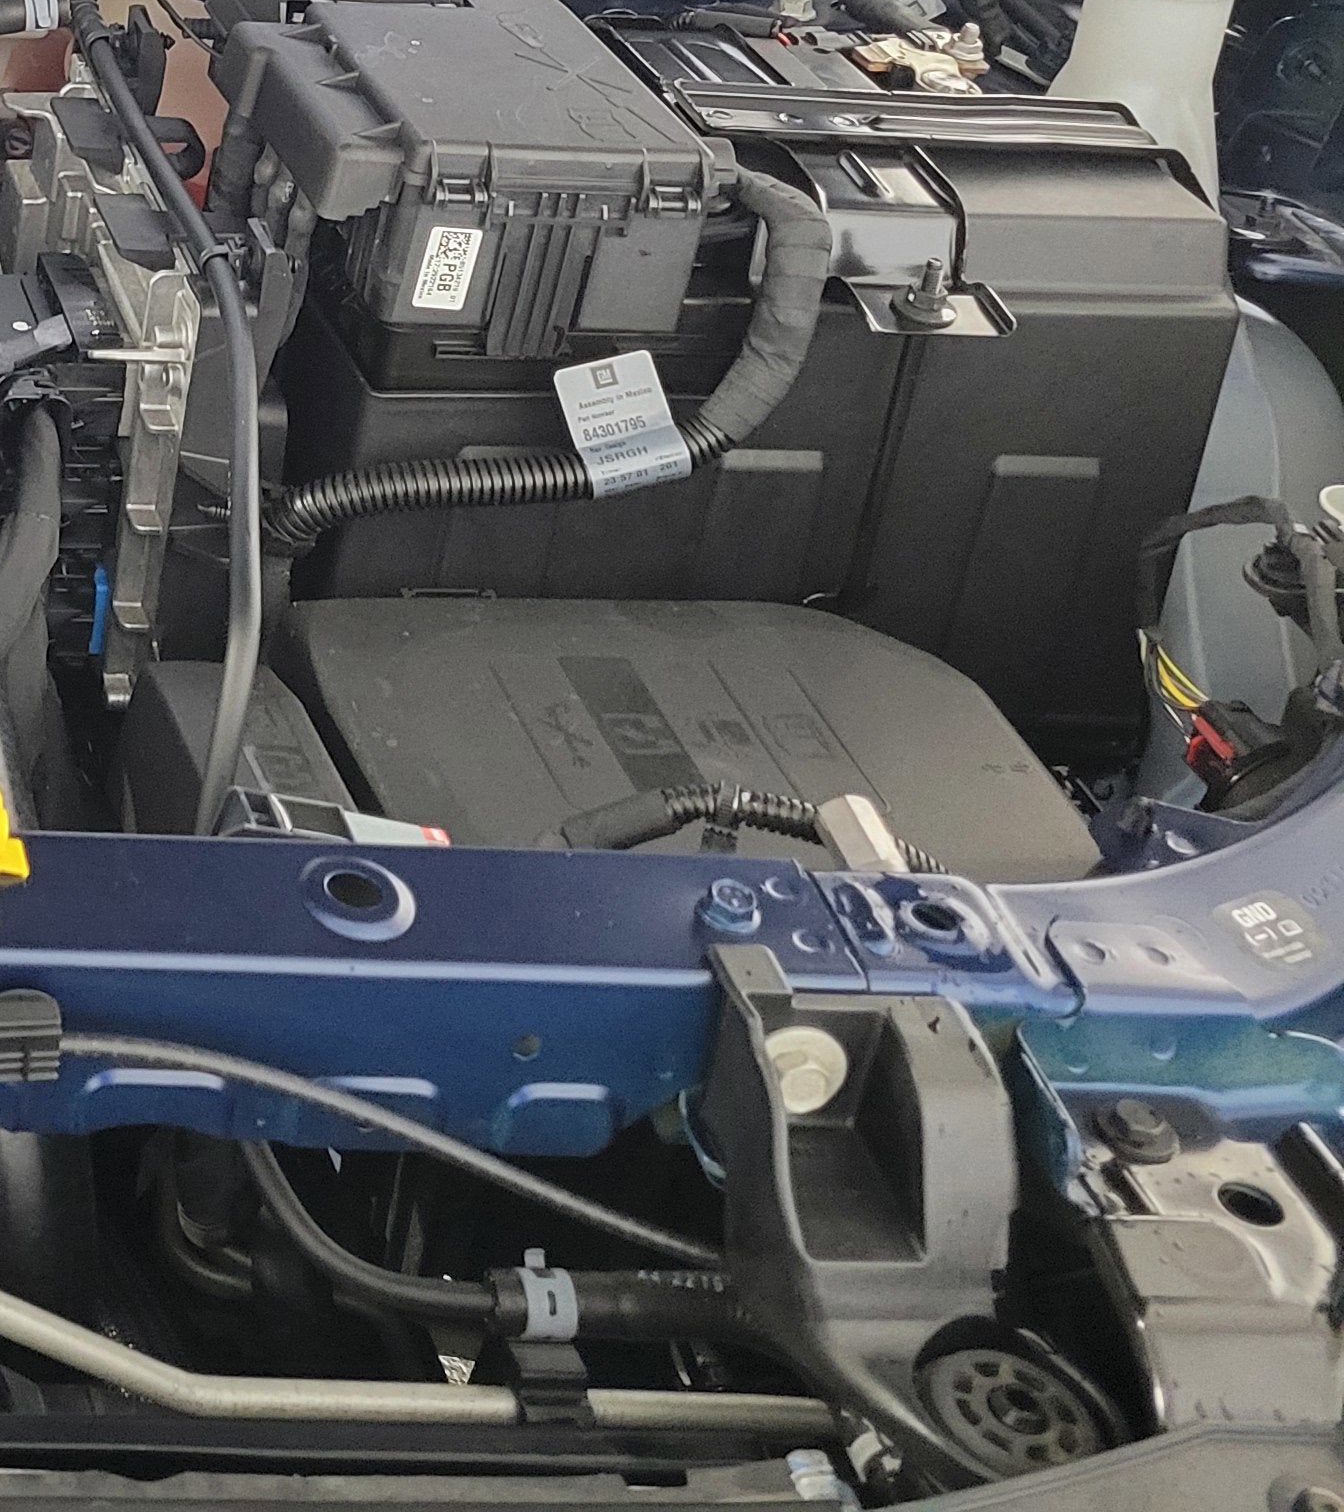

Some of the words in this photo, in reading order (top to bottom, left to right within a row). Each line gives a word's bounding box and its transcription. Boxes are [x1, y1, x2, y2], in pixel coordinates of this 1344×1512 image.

[435, 262, 457, 292] PGB
[595, 368, 612, 380] GM
[581, 415, 647, 442] 84301795
[594, 445, 648, 465] JSRGH
[1231, 901, 1278, 928] GND
